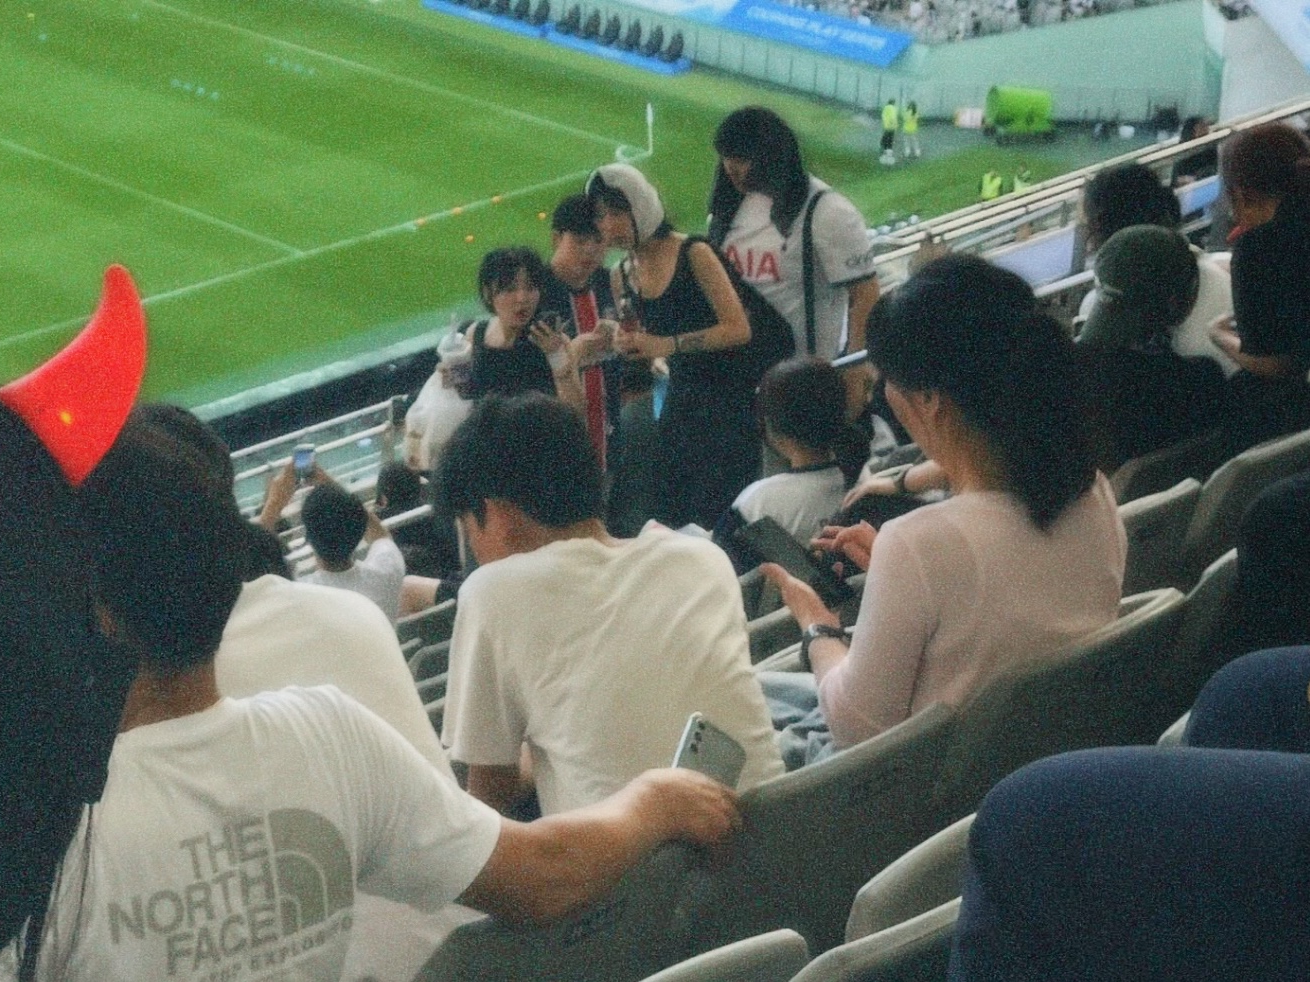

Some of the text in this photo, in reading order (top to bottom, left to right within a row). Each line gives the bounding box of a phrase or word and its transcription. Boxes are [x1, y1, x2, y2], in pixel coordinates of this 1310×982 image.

[726, 244, 781, 282] AIA
[179, 816, 269, 880] THE
[106, 859, 277, 945] NORTH
[165, 903, 280, 976] FACE
